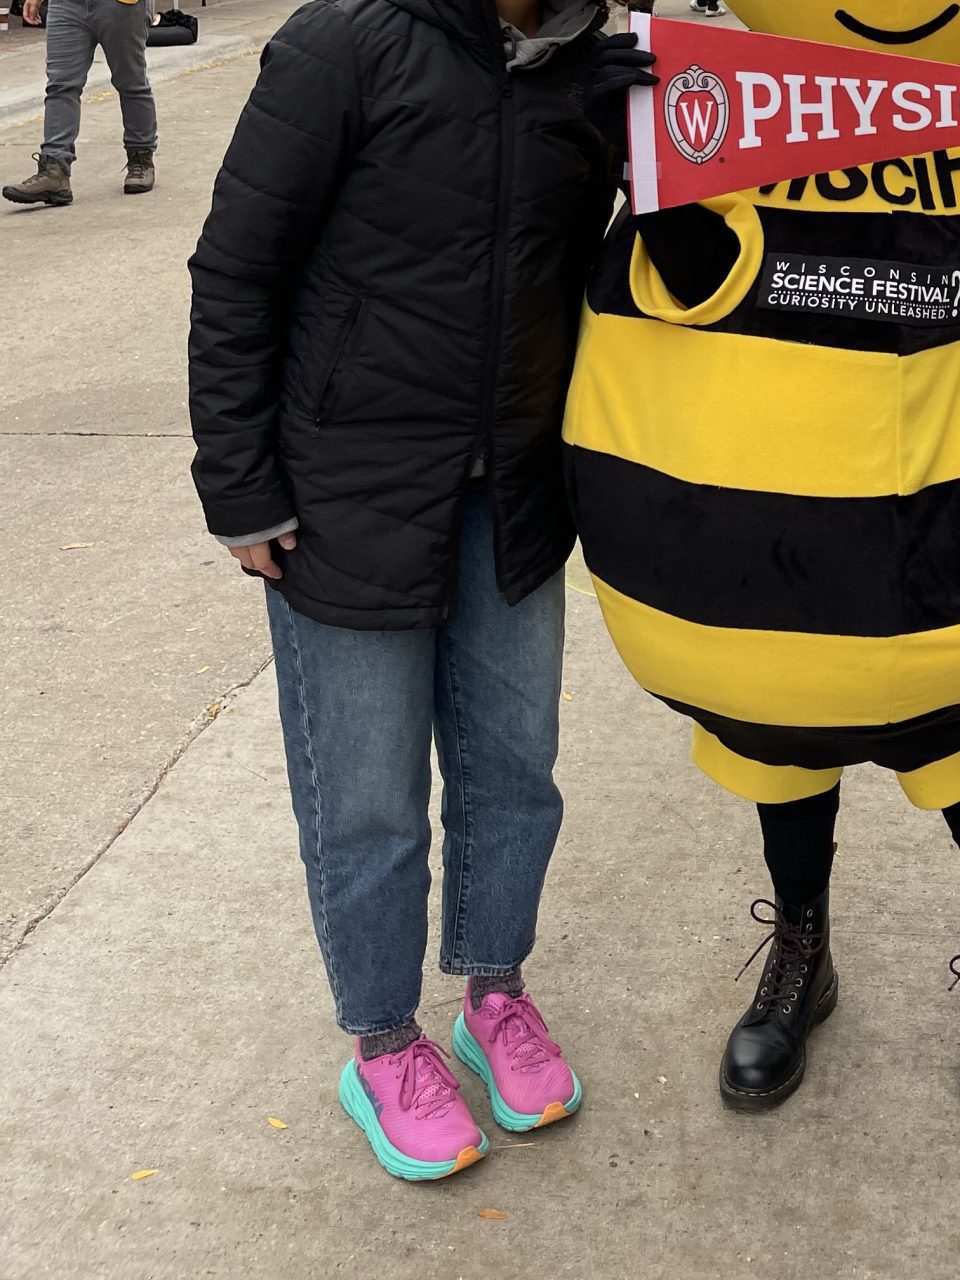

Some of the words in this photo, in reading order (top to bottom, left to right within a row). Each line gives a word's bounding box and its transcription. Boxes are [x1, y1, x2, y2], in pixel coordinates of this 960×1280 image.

[680, 99, 714, 144] W
[776, 261, 949, 285] WISCONSIN
[771, 273, 865, 295] SCIENCE
[872, 279, 950, 303] FESTIVAL
[767, 293, 858, 311] CURIOSITY
[865, 301, 949, 320] UNLEASHED.
